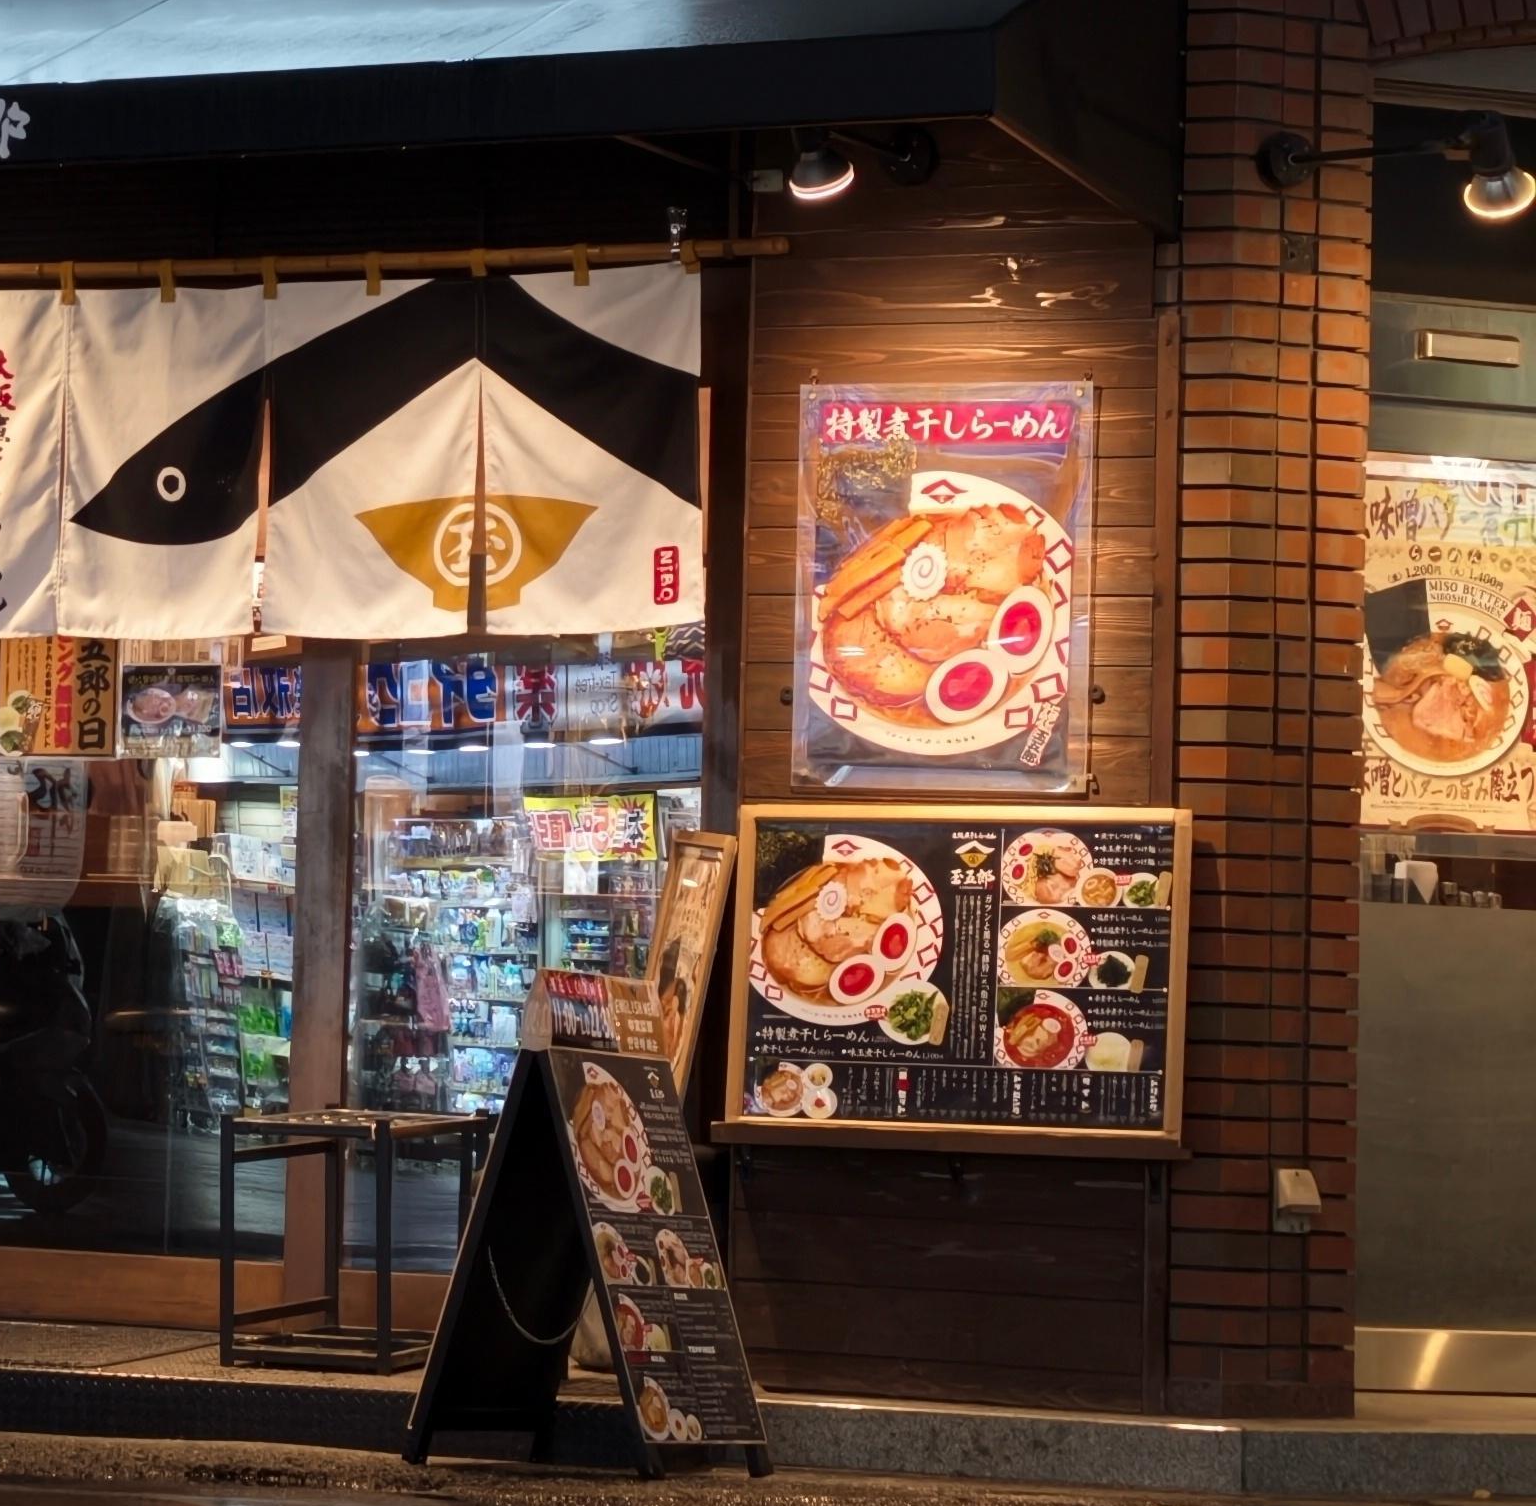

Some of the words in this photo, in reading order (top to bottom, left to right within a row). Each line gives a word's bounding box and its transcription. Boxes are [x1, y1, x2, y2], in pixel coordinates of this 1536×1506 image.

[825, 407, 1067, 441] 特製煮干しらーめん
[1428, 581, 1459, 592] MISO
[1463, 582, 1509, 612] BUTTER
